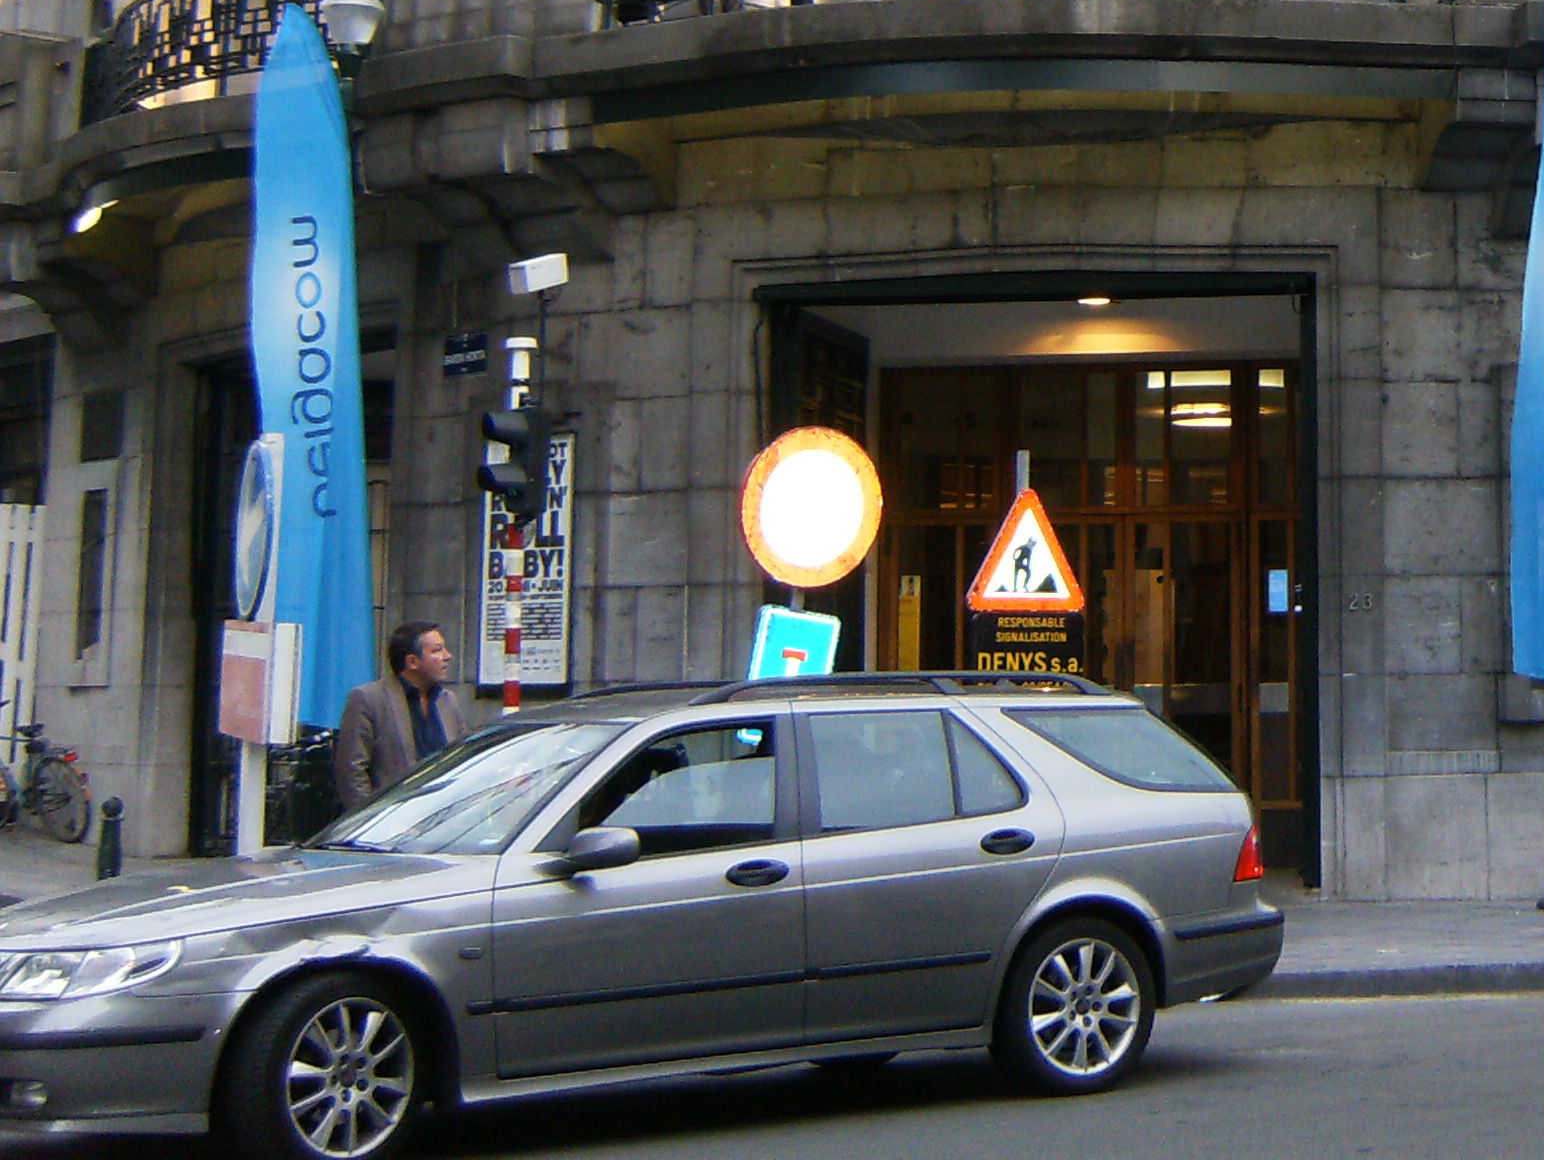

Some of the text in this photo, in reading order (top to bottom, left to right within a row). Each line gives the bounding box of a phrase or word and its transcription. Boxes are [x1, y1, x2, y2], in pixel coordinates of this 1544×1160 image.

[489, 549, 564, 579] BBY!
[1348, 592, 1373, 610] 23
[997, 617, 1066, 628] RESPONSABLE
[995, 631, 1067, 642] SIGNALISATION
[1050, 657, 1084, 673] s.a.
